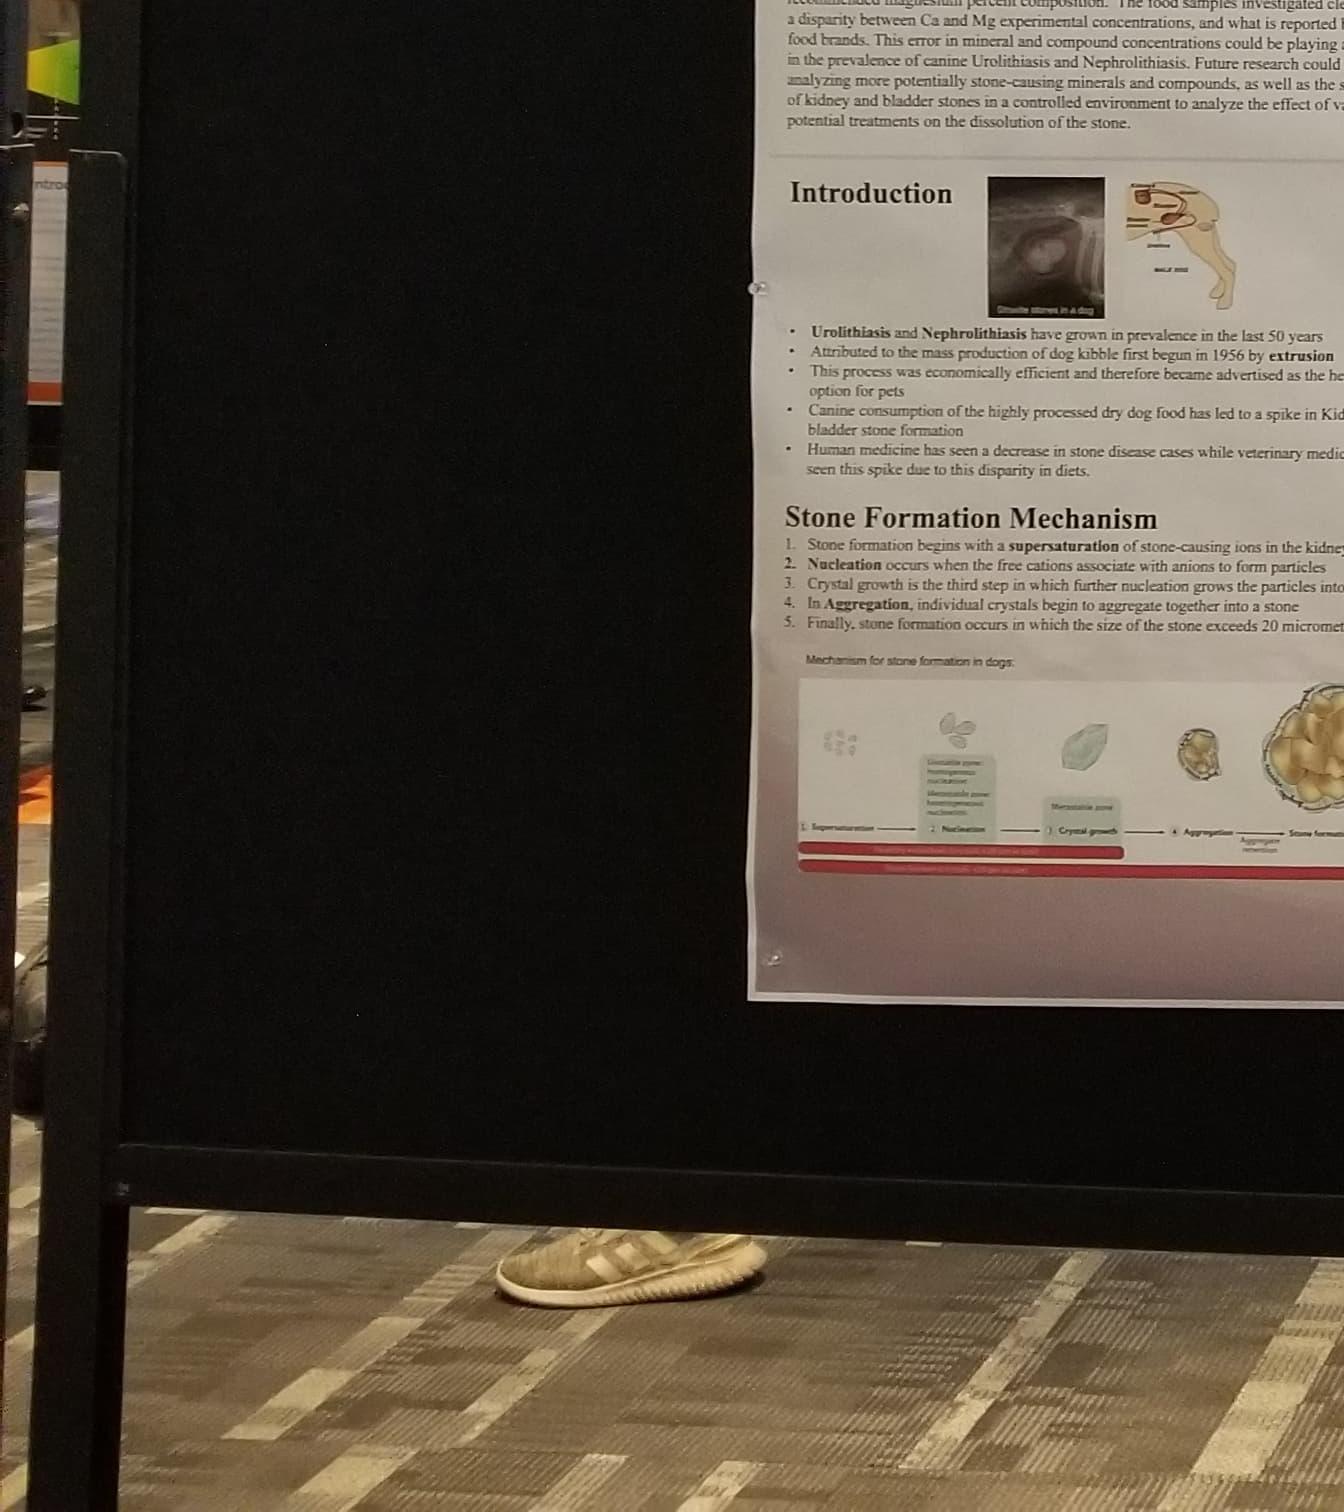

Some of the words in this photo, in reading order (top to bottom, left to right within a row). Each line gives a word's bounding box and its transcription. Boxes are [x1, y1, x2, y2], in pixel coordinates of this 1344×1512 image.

[791, 181, 953, 204] Introduction
[785, 505, 856, 529] Stone
[864, 506, 1001, 529] Formation
[1009, 507, 1158, 530] Mechanism
